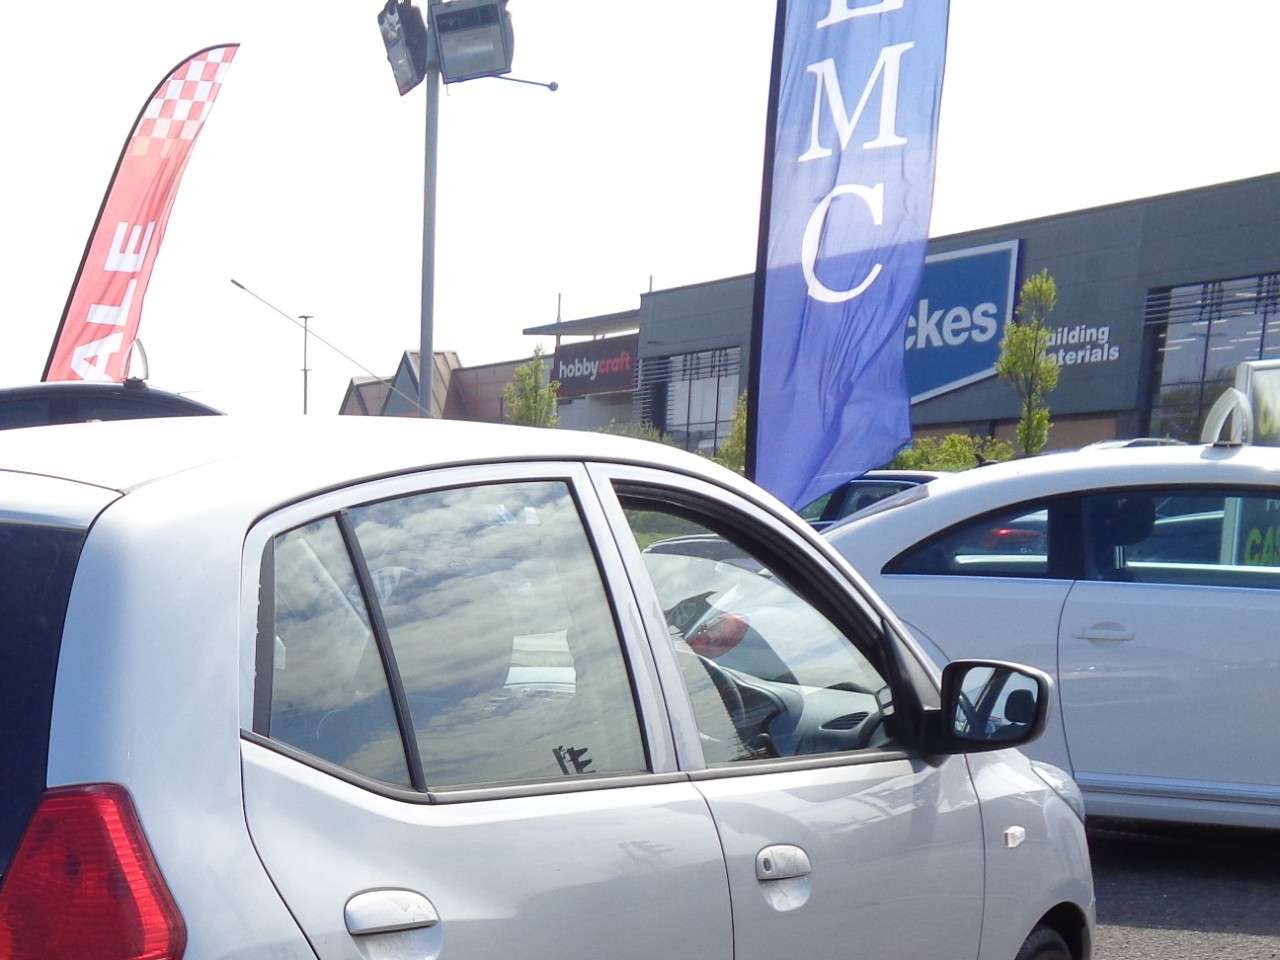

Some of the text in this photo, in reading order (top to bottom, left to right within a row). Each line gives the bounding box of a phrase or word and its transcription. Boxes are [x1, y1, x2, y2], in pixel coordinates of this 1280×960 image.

[71, 221, 157, 382] ALE
[1038, 325, 1110, 347] uilding
[559, 351, 631, 381] hobbycraft
[1039, 344, 1120, 366] aterials
